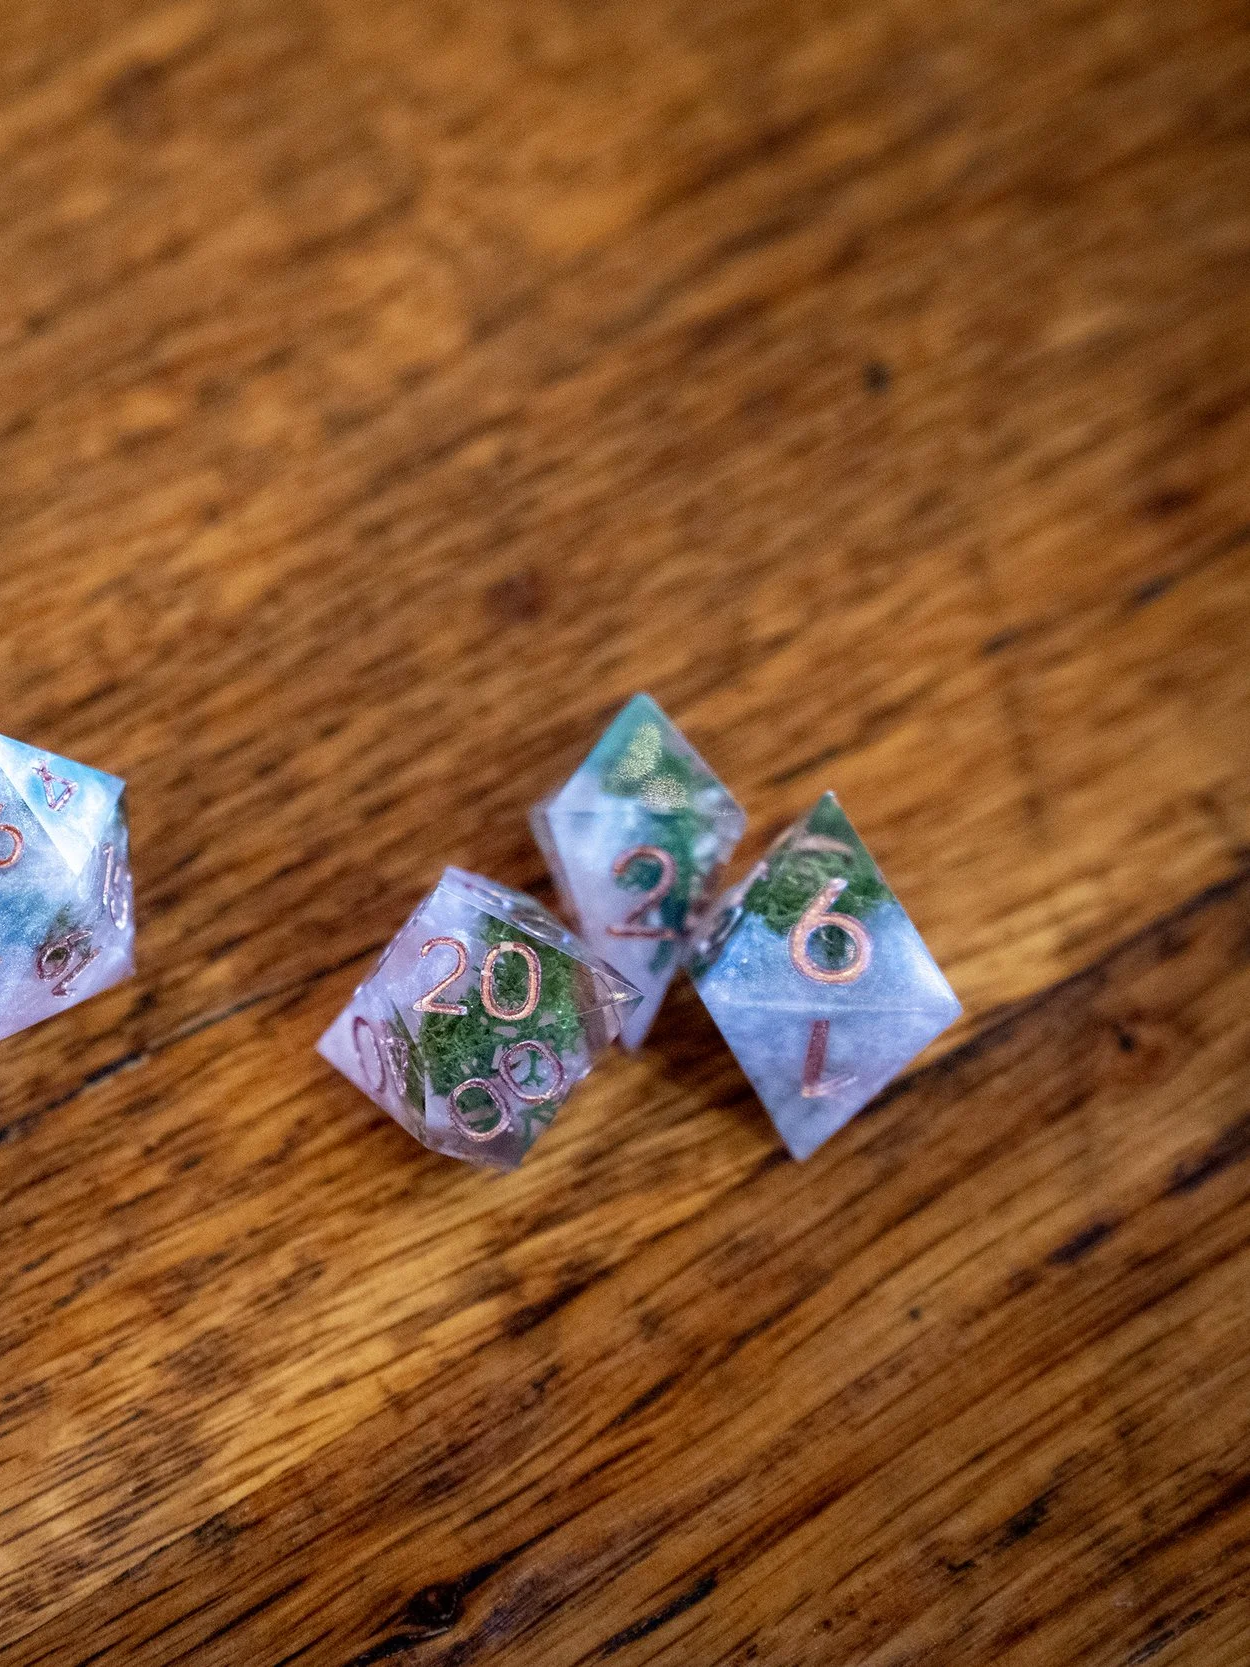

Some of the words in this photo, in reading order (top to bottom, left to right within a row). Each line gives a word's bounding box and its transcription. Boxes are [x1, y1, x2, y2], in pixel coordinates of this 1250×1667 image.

[606, 845, 678, 940] 2
[786, 877, 874, 985] 6
[413, 936, 542, 1021] 20
